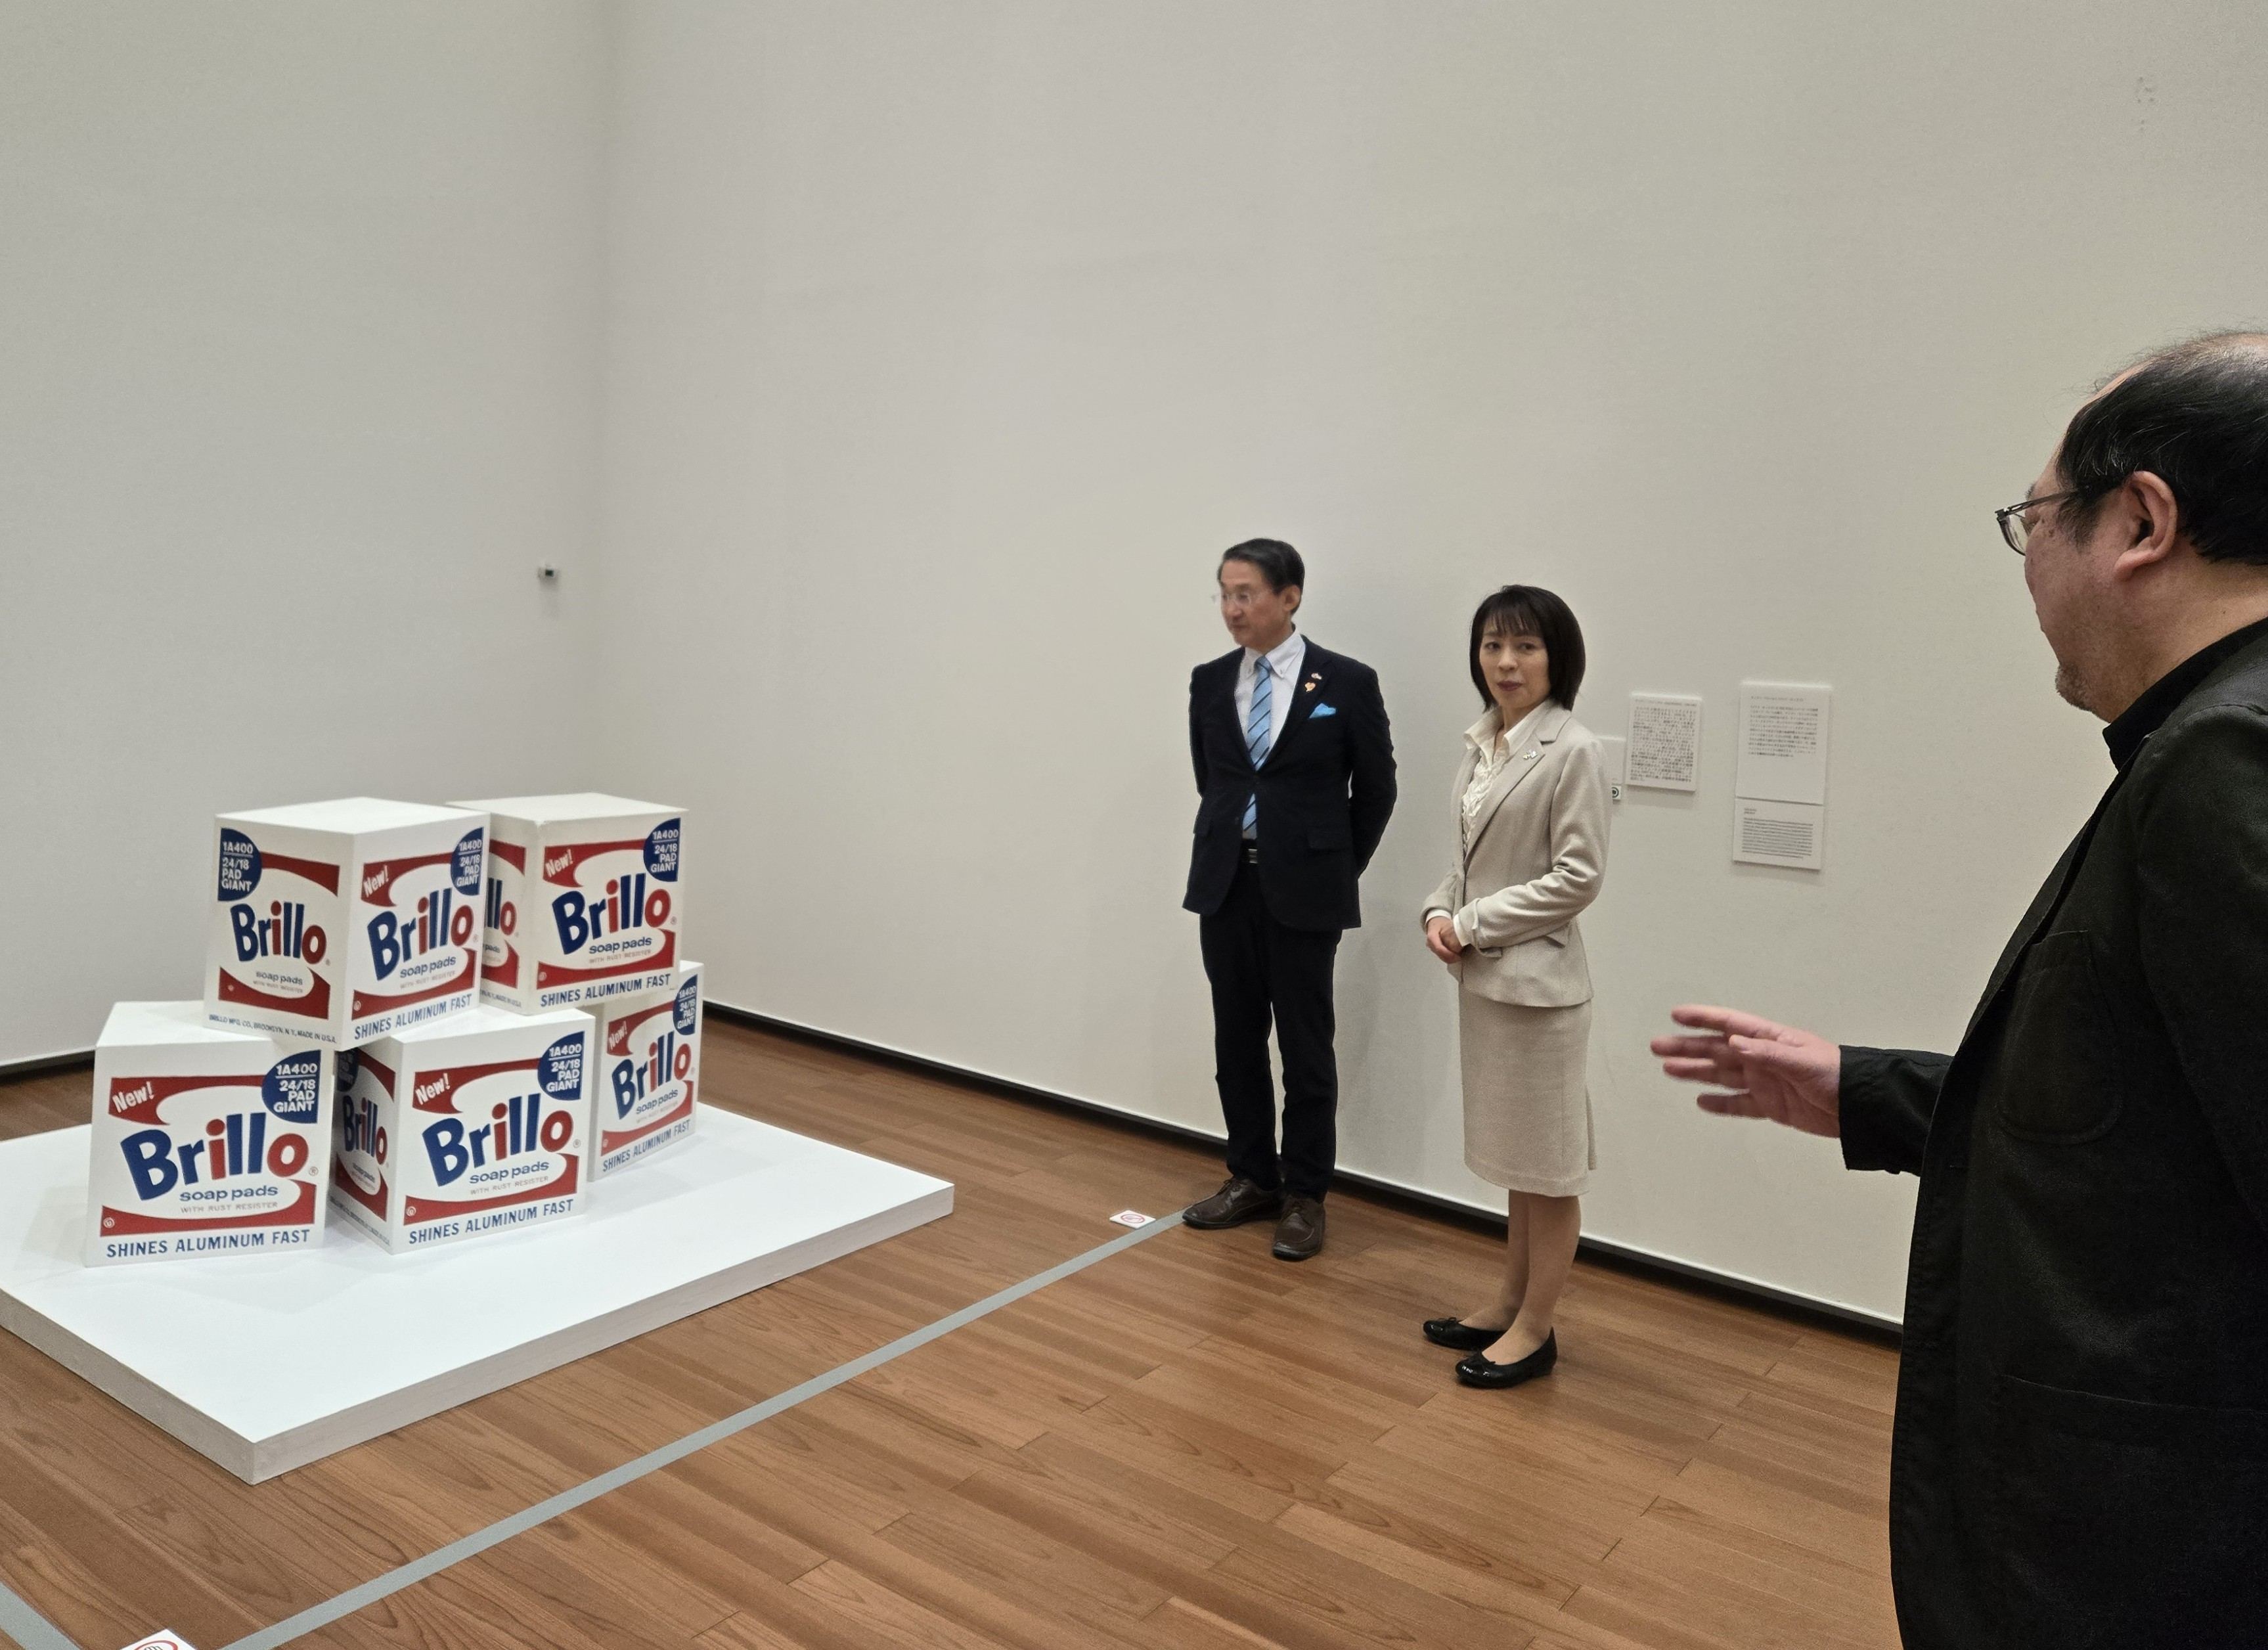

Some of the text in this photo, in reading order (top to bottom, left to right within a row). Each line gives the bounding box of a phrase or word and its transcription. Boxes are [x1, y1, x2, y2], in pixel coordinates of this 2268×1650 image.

[653, 829, 678, 840] 1A400
[223, 841, 254, 854] 1A400
[459, 839, 482, 852] 1A400
[654, 843, 677, 854] 24/18
[222, 857, 250, 870] 24/18
[460, 854, 480, 868] 24/18
[545, 849, 573, 878] New!
[659, 853, 677, 863] PAD
[222, 868, 242, 880] PAD
[464, 864, 479, 877] PAD
[651, 862, 676, 873] GIANT
[221, 878, 252, 892] GIANT
[363, 866, 389, 898] New!
[456, 874, 479, 888] GIANT
[485, 878, 517, 936] llo
[552, 873, 671, 955] Brillo
[230, 900, 326, 964] Brillo
[367, 887, 474, 981] Brillo
[589, 937, 652, 954] soap pads
[400, 964, 428, 978] soap
[430, 956, 456, 973] pads
[256, 971, 303, 985] soap pads
[541, 989, 581, 1007] SHINES
[585, 979, 642, 999] ALUMINUM
[646, 973, 671, 989] FAST
[355, 1017, 391, 1040] SHINES
[395, 1001, 447, 1028] ALUMINUM
[451, 994, 472, 1011] FAST
[677, 1015, 694, 1029] GIANT
[549, 1043, 582, 1057] 1A400
[276, 1063, 317, 1075] 1A400
[551, 1059, 581, 1072] 24/18
[558, 1069, 580, 1081] PAD
[611, 1031, 691, 1119] Brillo
[278, 1079, 316, 1092] 24/18
[415, 1073, 451, 1105] New!
[546, 1079, 579, 1092] GIANT
[112, 1081, 154, 1113] New!
[288, 1090, 315, 1102] PAD
[636, 1100, 657, 1114] soap
[658, 1090, 678, 1107] pads
[273, 1100, 315, 1113] GIANT
[342, 1095, 388, 1165] Brillo
[422, 1093, 573, 1187] Brillo
[603, 1119, 690, 1172] SHINES ALUMINUM FAST
[120, 1112, 309, 1201] Brillo
[469, 1161, 550, 1184] soap pads
[179, 1185, 278, 1201] soap pads
[236, 1201, 278, 1211] RESISTER
[409, 1199, 573, 1244] SHINES ALUMINUM FAST
[106, 1229, 310, 1257] SHINES ALUMINUM FAST
